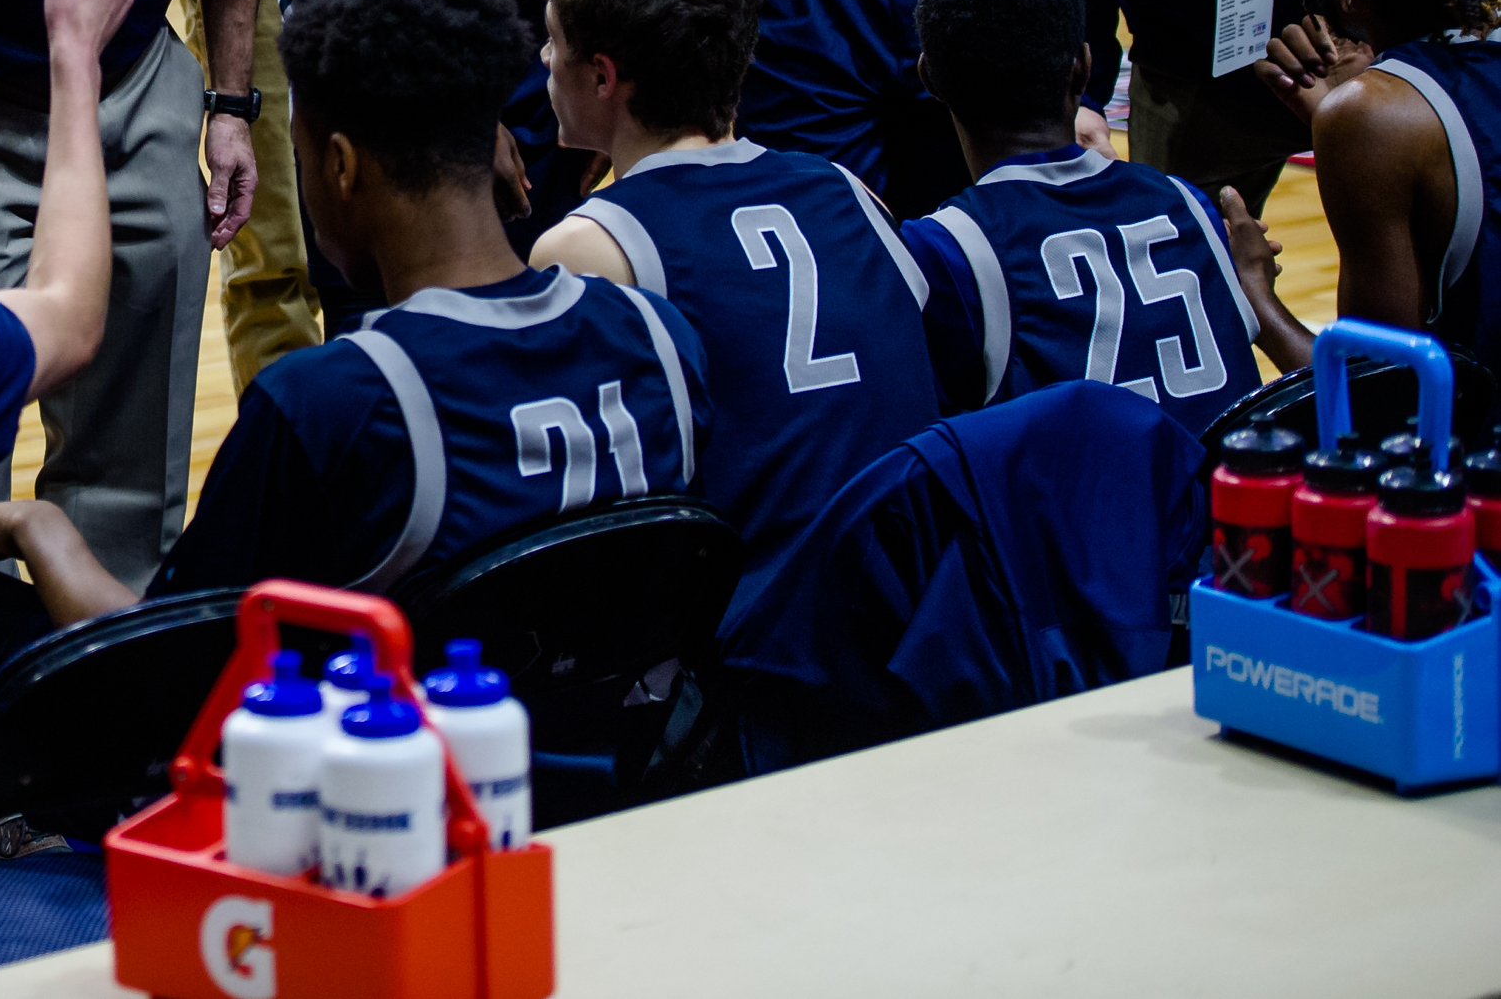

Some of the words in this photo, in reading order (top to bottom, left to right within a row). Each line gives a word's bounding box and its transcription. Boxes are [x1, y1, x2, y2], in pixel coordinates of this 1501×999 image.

[731, 203, 861, 394] 2
[1040, 214, 1228, 403] 25
[1206, 644, 1380, 724] POWERADE
[201, 894, 275, 998] G
